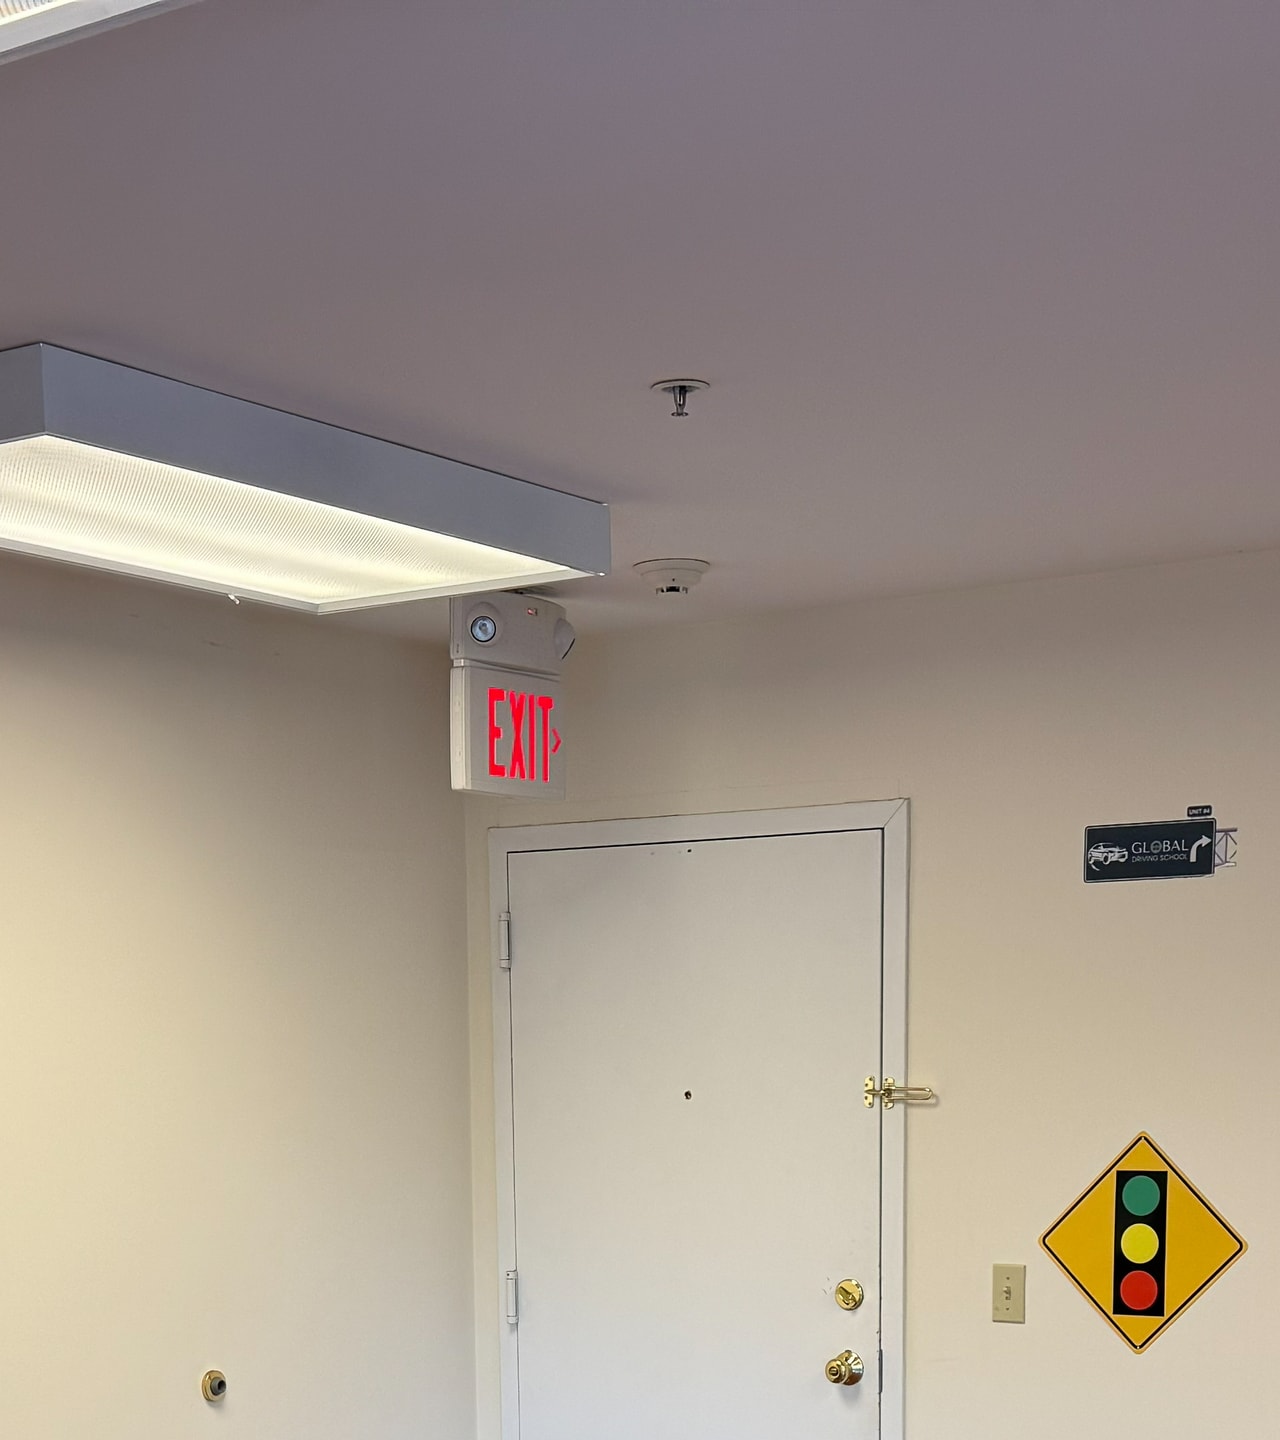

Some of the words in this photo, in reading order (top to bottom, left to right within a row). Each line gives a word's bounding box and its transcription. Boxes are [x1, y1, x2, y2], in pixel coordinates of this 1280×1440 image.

[487, 686, 554, 783] EXIT
[1131, 839, 1189, 854] GLOBAL
[1131, 855, 1159, 863] DRIVING
[1160, 853, 1188, 862] SCHOOL
